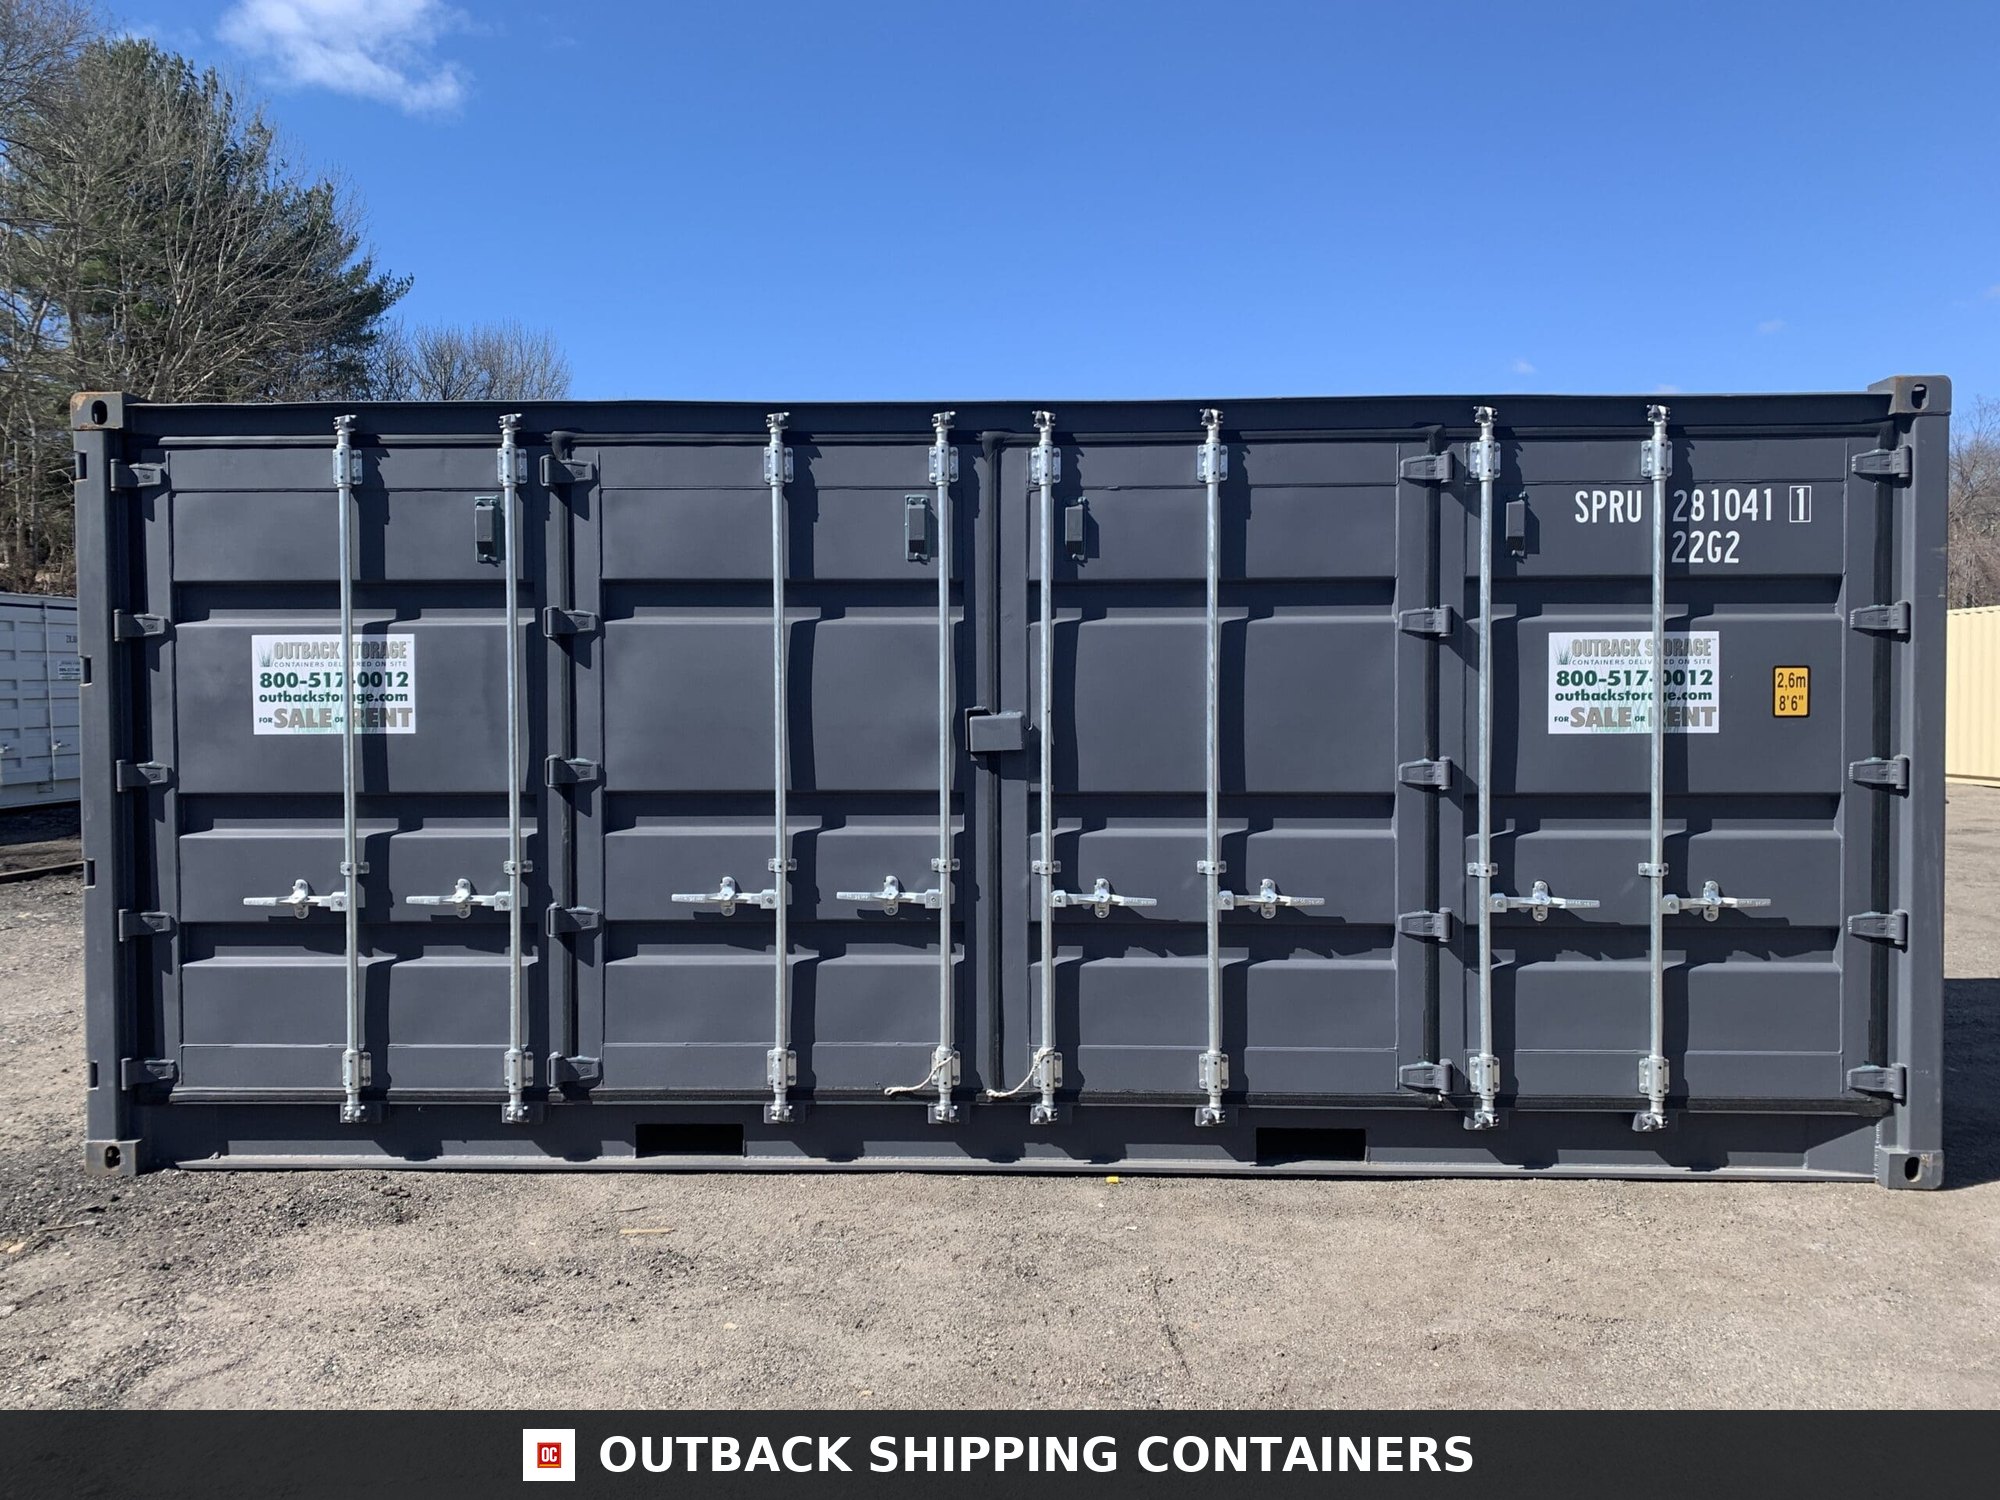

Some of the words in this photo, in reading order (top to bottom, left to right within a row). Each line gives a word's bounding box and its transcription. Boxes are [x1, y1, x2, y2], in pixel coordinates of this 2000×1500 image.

[1575, 490, 1642, 523] SPRU
[1672, 488, 1772, 521] 281041
[1671, 530, 1740, 563] 22G2
[274, 642, 340, 660] OUTBACK
[351, 641, 407, 659] TORAGE
[1572, 639, 1641, 657] OUTBACK
[1644, 638, 1711, 656] SORAGE
[1777, 672, 1806, 691] 2,6m
[274, 708, 332, 728] SALE
[352, 707, 413, 728] RENT
[1570, 706, 1632, 727] SALE
